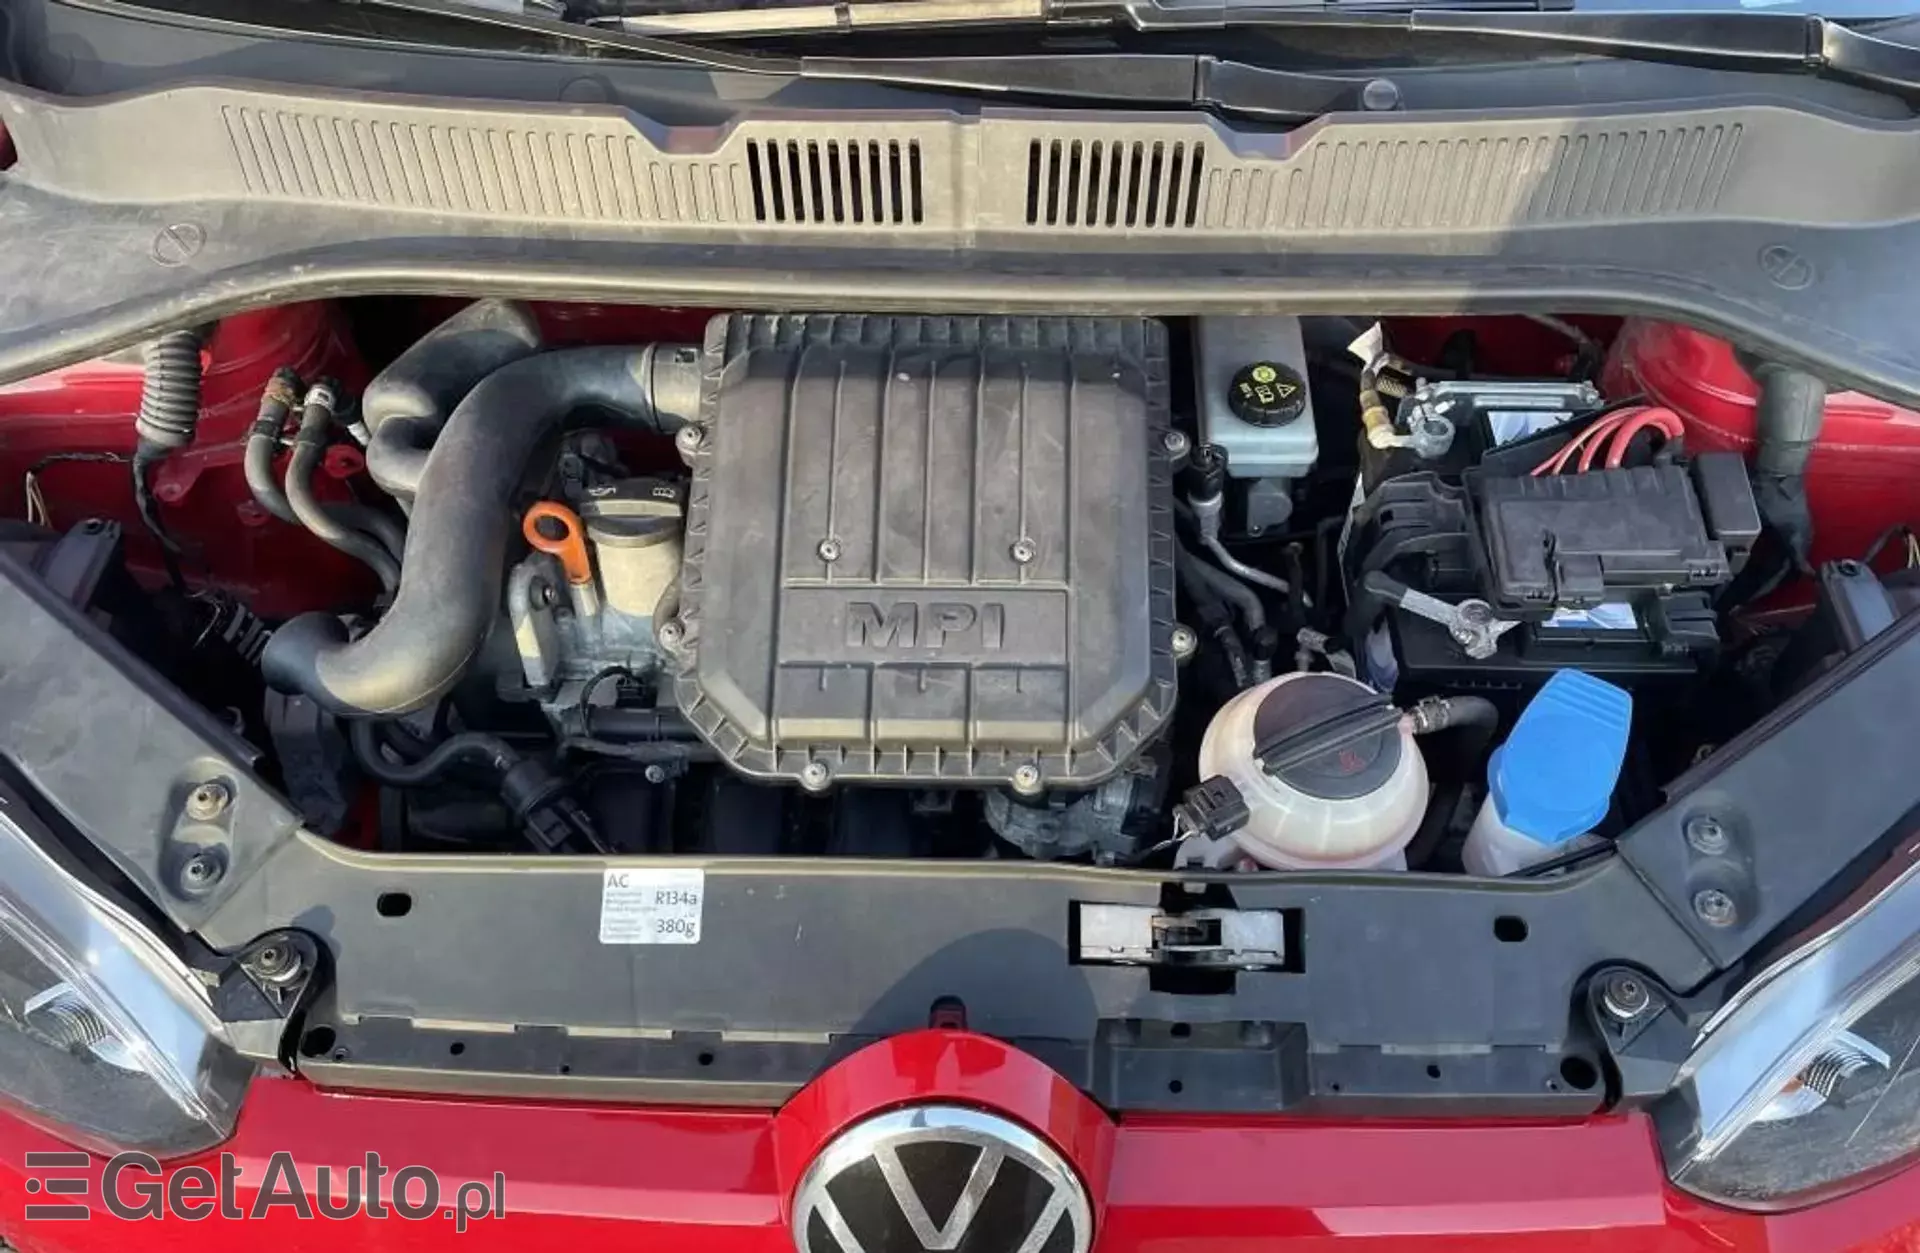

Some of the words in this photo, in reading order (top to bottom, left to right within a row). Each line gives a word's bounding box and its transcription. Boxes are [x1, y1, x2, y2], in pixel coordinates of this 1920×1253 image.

[846, 601, 1005, 649] MPI
[607, 873, 629, 888] AC
[655, 891, 698, 905] R134a
[656, 919, 695, 938] 380g
